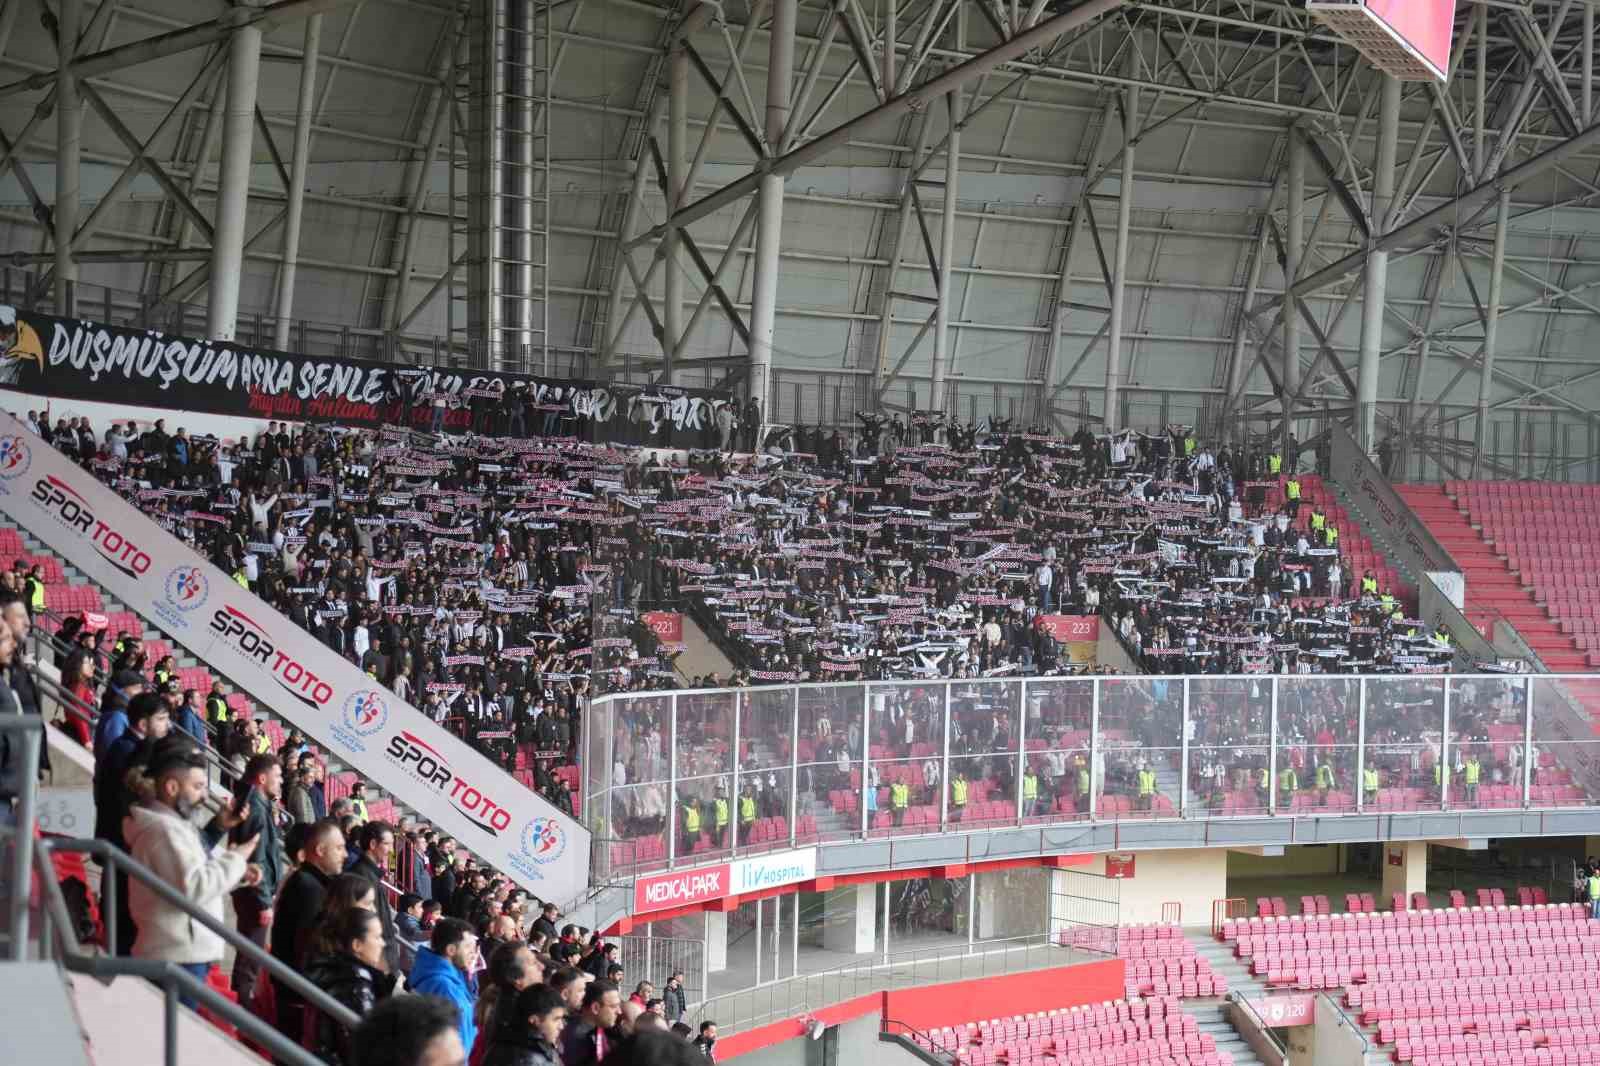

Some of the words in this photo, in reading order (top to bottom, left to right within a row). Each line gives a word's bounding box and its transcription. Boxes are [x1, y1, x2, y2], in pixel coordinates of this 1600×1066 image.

[48, 319, 238, 391] DÜŞMÜŞÜM
[296, 361, 386, 404] SENLE
[656, 621, 673, 633] 221
[1072, 622, 1090, 634] 223
[764, 865, 805, 884] HOSPITAL
[1286, 1004, 1305, 1017] 120
